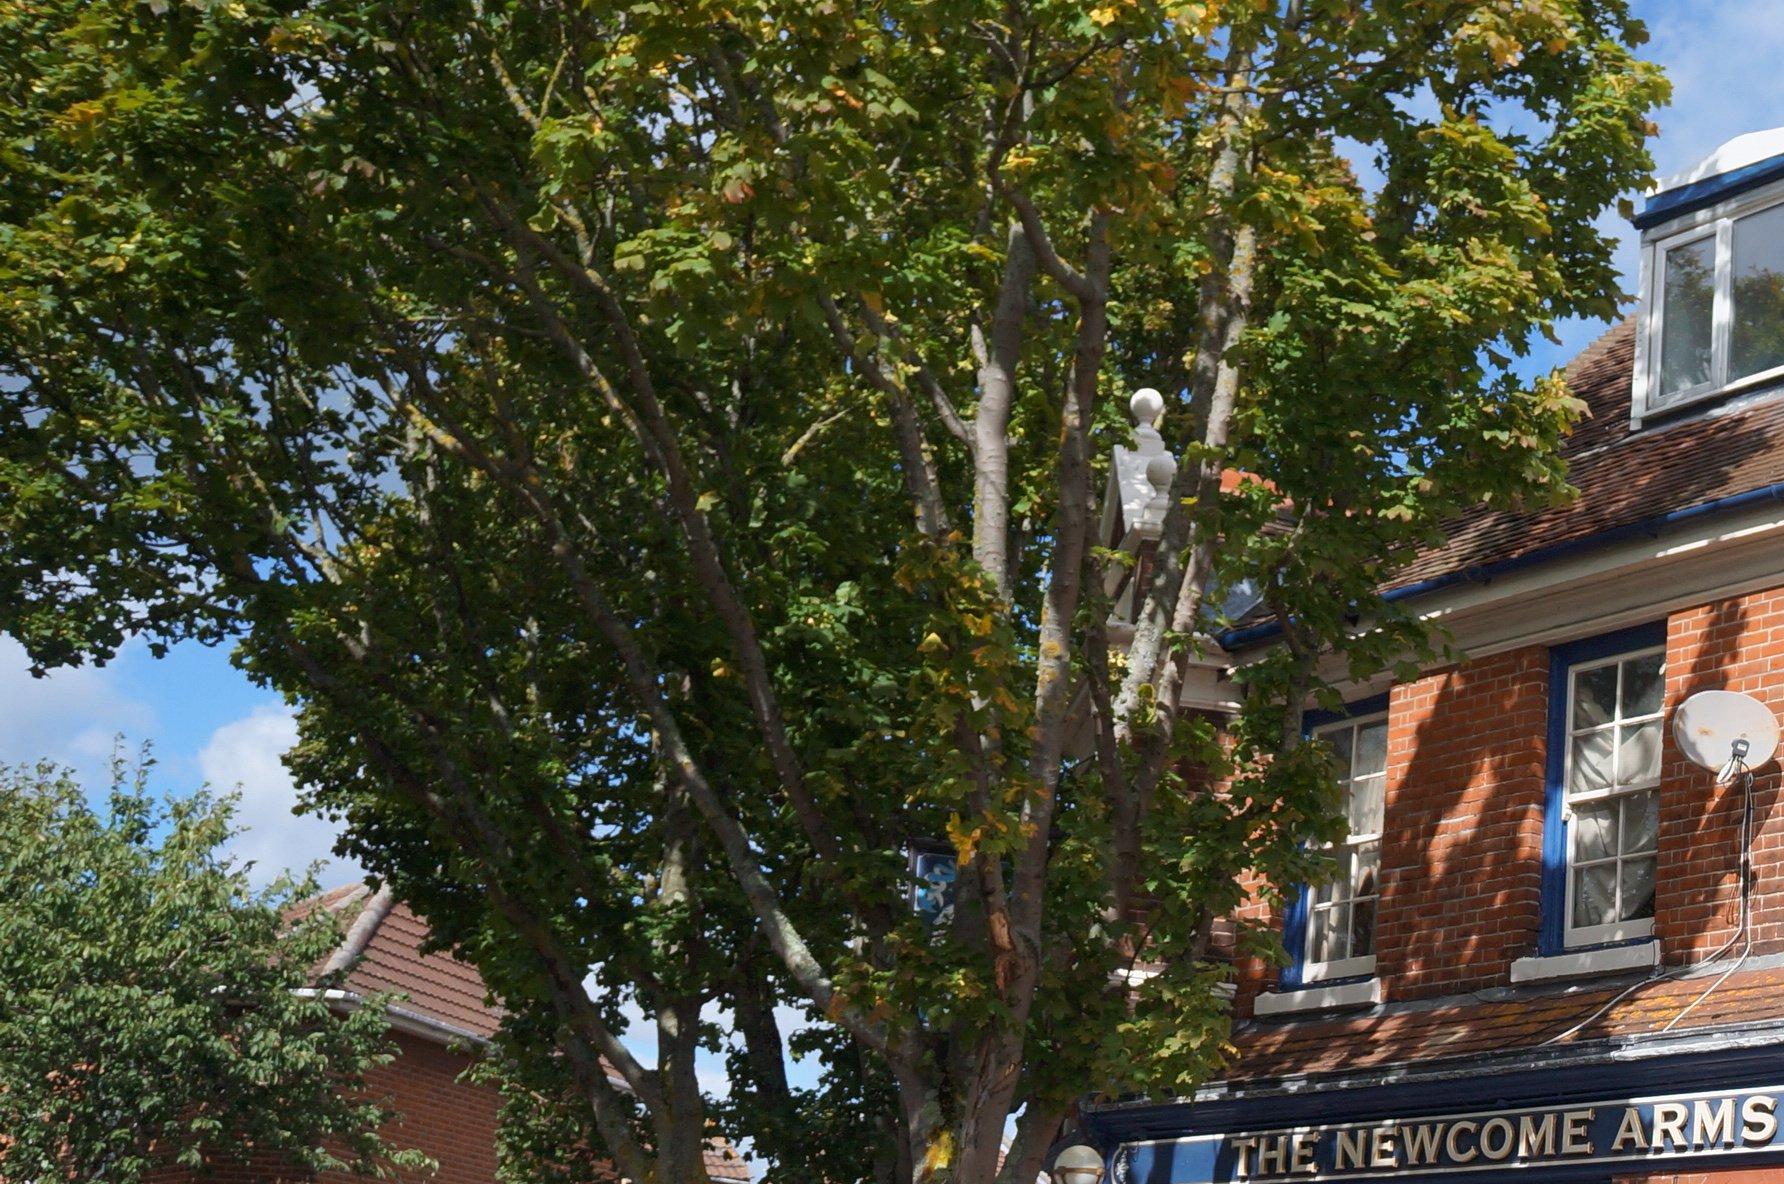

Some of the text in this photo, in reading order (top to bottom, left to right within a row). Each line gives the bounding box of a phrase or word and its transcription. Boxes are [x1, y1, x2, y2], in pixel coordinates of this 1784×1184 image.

[1231, 1095, 1778, 1177] THE NEWCOME ARMS
